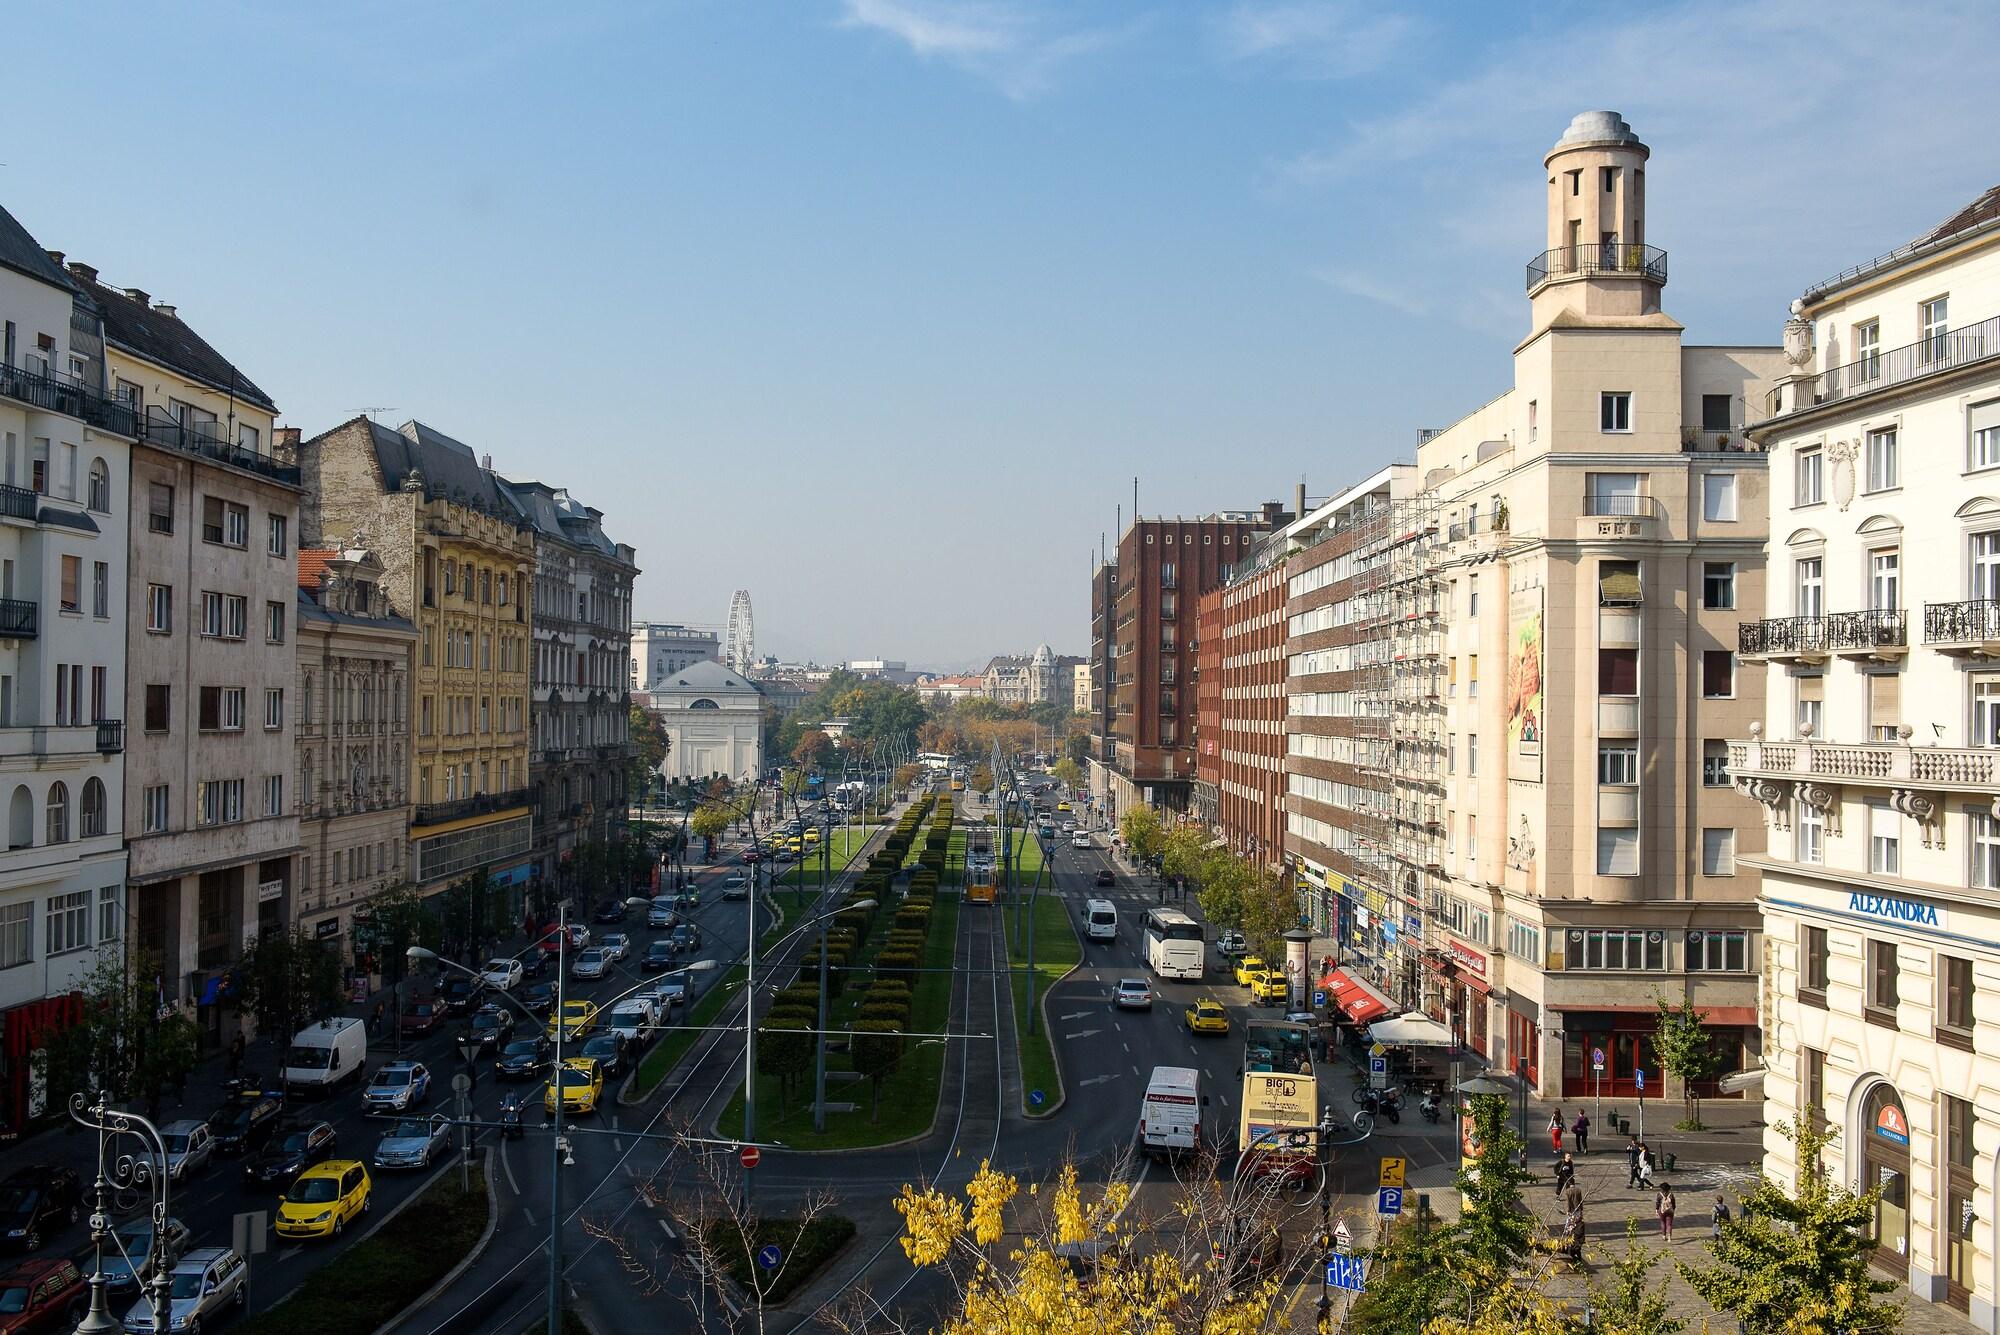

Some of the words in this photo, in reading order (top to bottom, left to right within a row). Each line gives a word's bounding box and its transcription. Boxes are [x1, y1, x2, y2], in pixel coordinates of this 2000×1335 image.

[1849, 892, 1938, 926] ALEXANDRA
[1315, 992, 1324, 1003] P
[1763, 939, 1772, 1052] ALEXANDRA
[1374, 1060, 1382, 1070] P
[1266, 1078, 1283, 1088] BIG
[1265, 1088, 1282, 1096] BUS
[1386, 1192, 1397, 1206] P
